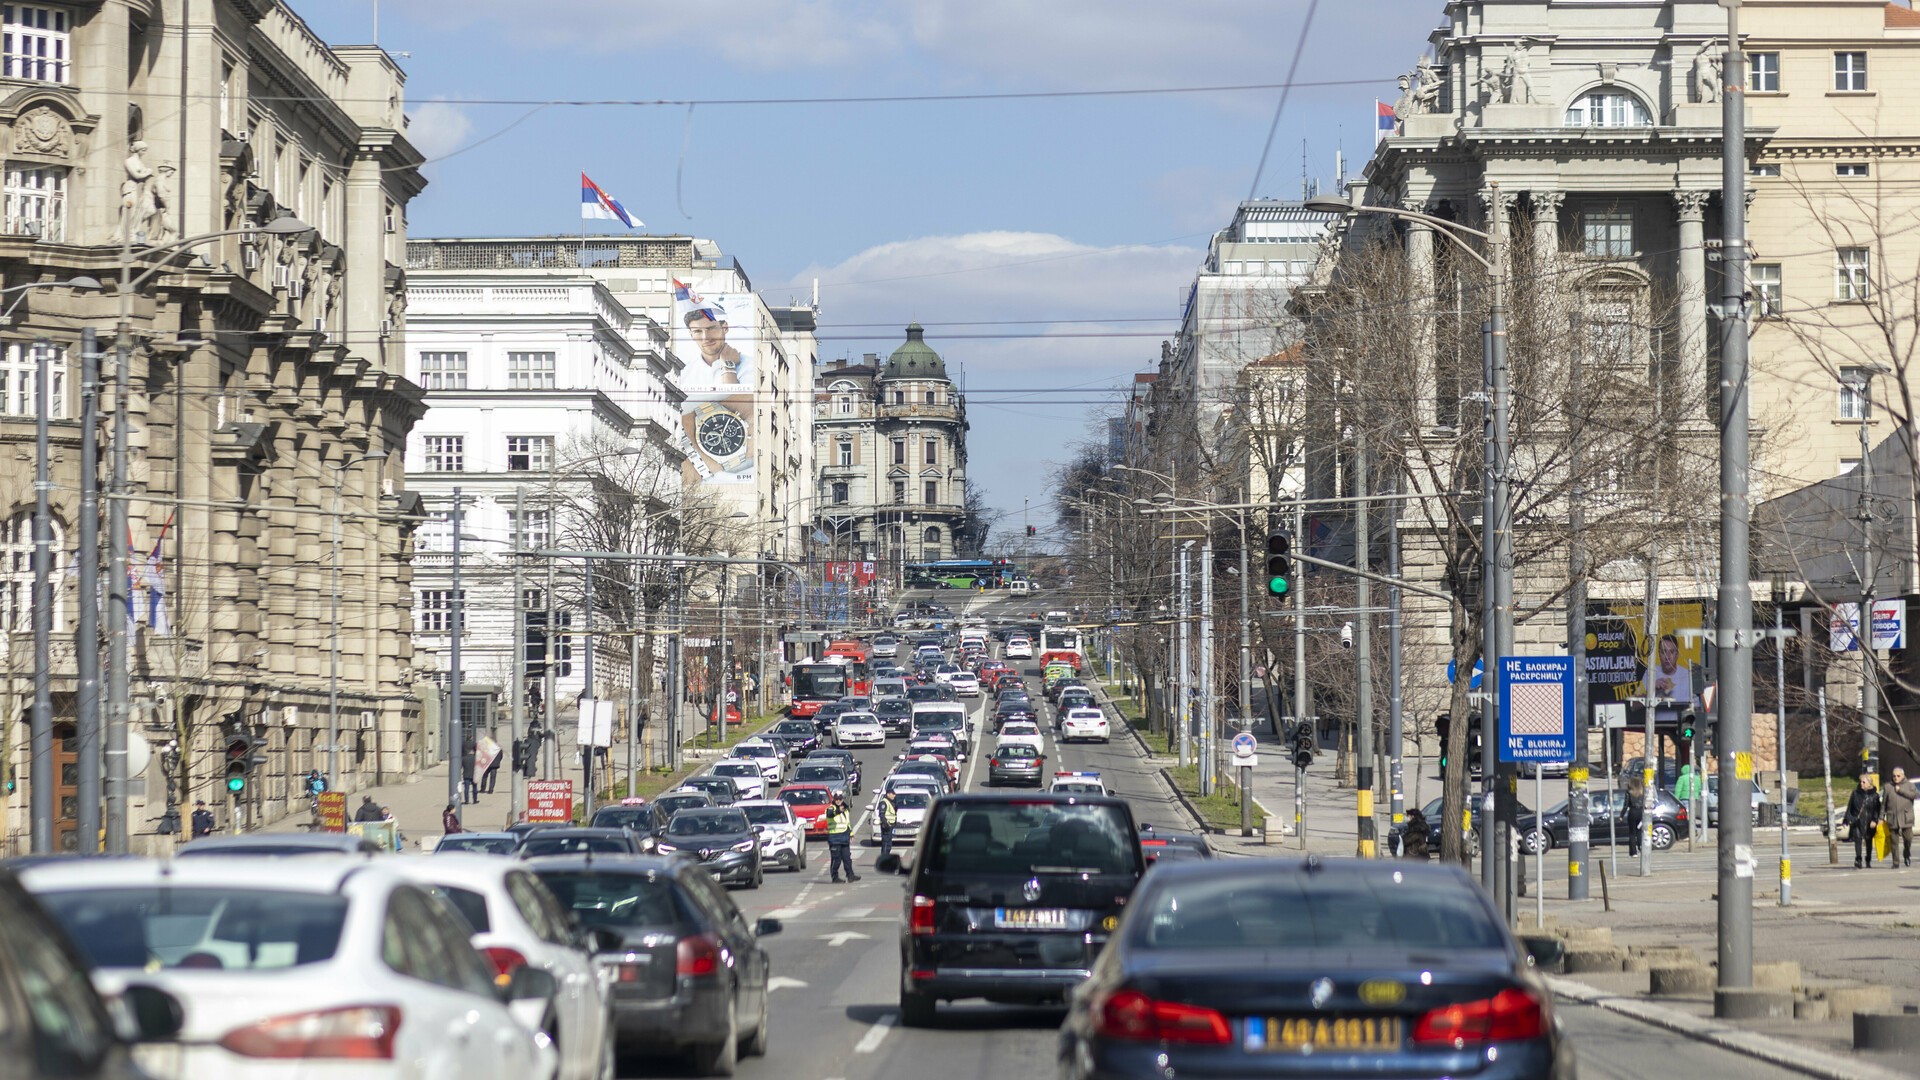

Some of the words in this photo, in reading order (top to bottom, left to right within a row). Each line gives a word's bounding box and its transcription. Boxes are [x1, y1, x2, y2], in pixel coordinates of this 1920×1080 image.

[1597, 632, 1625, 640] BALKAN
[1506, 660, 1522, 672] НЕ
[1525, 663, 1568, 672] БЛОКИРАЈ
[1585, 655, 1636, 671] ASTAVLJENA
[1510, 672, 1563, 681] РАСКРСНИЦУ
[1508, 737, 1524, 749] NE
[1527, 740, 1567, 748] BLOKIRAJ
[1512, 748, 1562, 758] RASKRSNICU
[529, 791, 564, 800] ПОДМЕТАТИ
[538, 800, 554, 808] НИКО
[528, 808, 544, 817] НЕМА
[544, 808, 564, 817] ПРАВО
